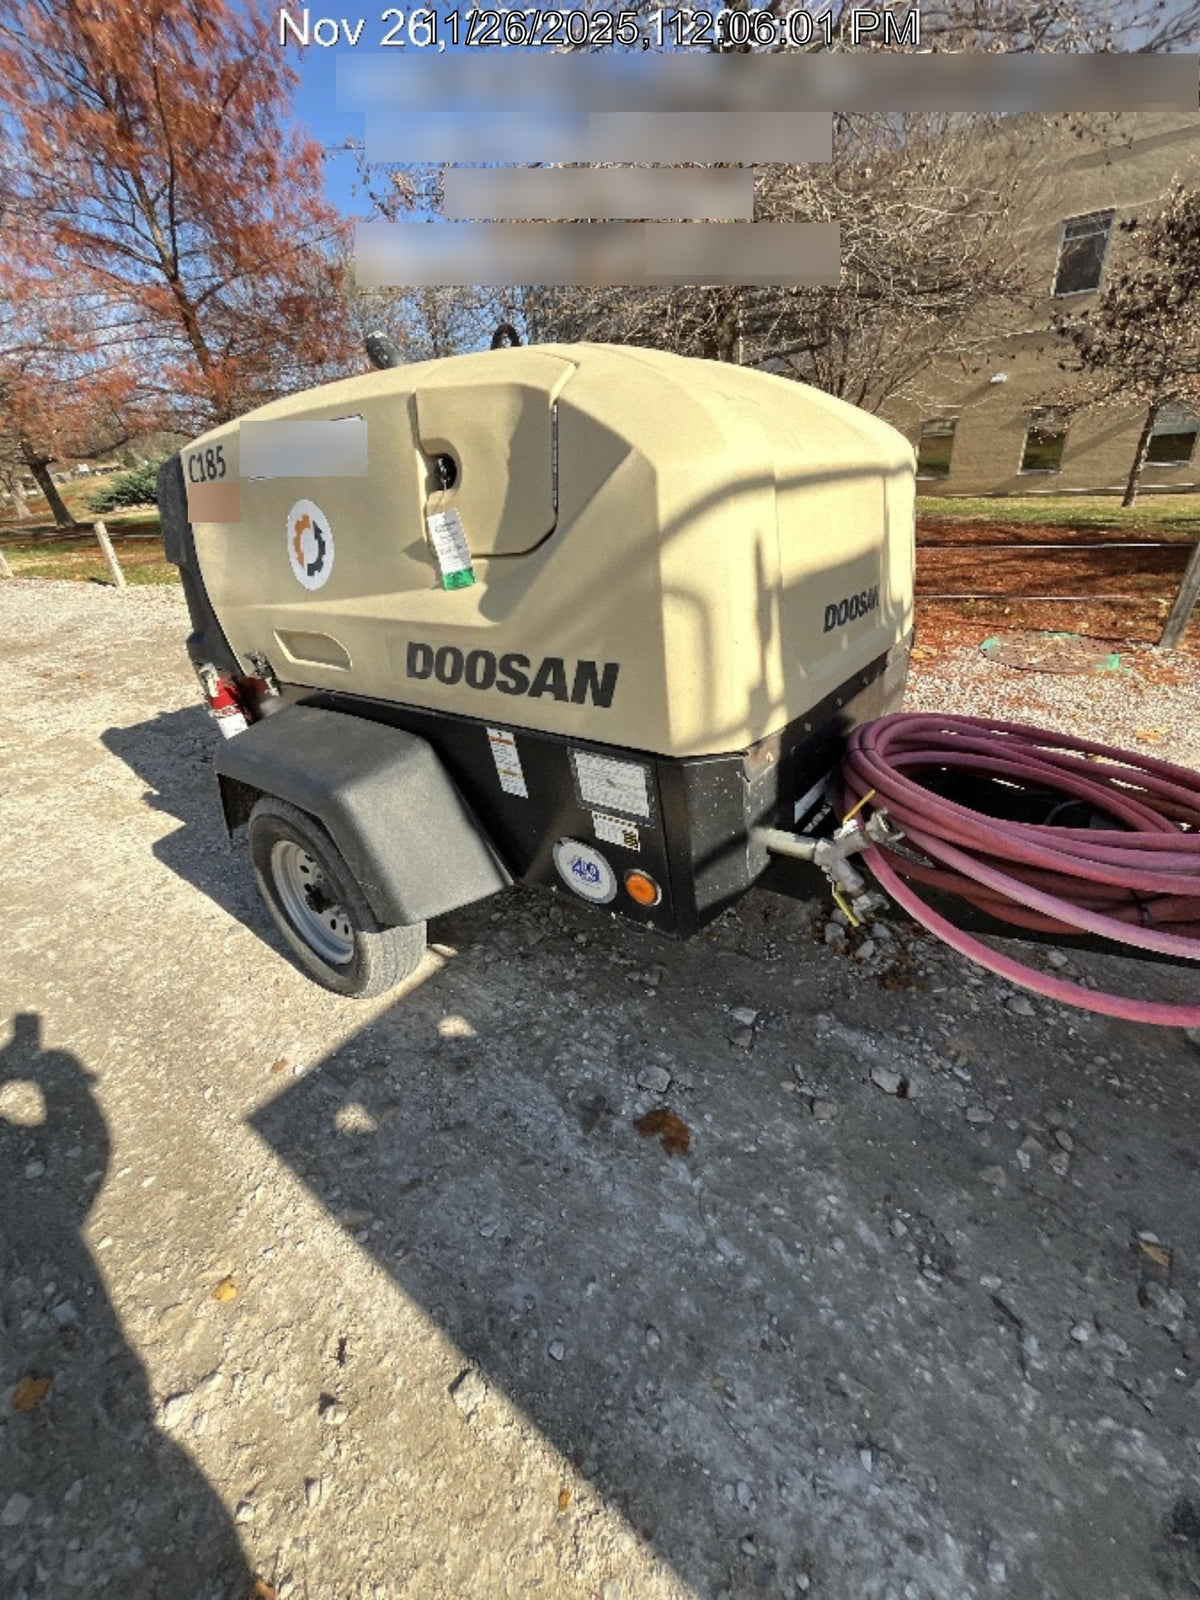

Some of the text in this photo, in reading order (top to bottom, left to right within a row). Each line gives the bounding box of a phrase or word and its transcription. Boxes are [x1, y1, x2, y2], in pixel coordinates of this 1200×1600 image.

[189, 445, 226, 482] C185
[823, 583, 880, 633] DOOSAN
[407, 642, 619, 708] DOOSAN
